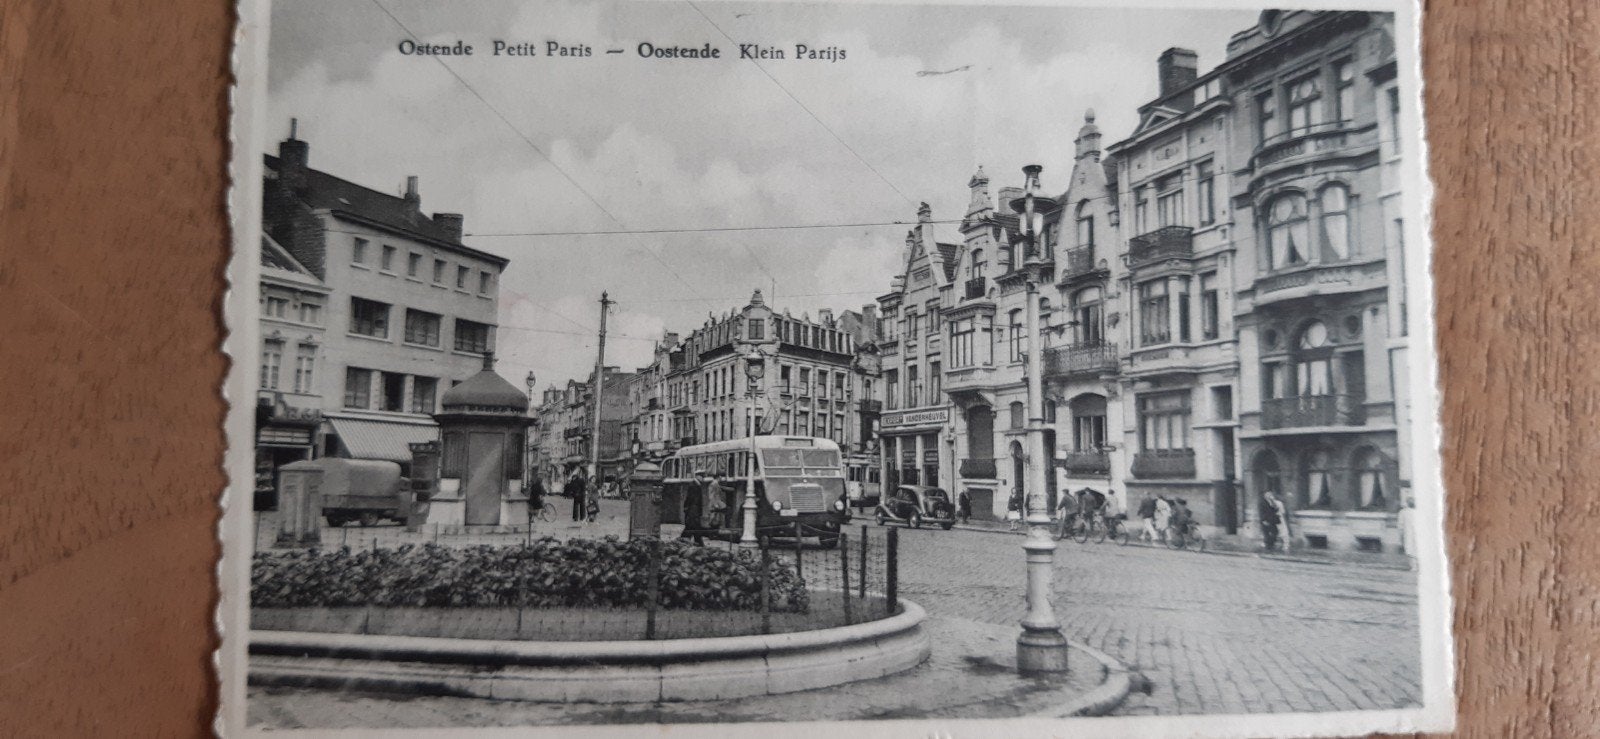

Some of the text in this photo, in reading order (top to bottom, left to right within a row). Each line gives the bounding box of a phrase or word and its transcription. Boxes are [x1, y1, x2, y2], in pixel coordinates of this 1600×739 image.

[398, 39, 474, 56] Ostende
[493, 40, 536, 57] Petit
[546, 41, 592, 57] Paris
[637, 42, 720, 59] Oostende
[739, 44, 785, 60] Klein
[795, 44, 846, 63] Parijs
